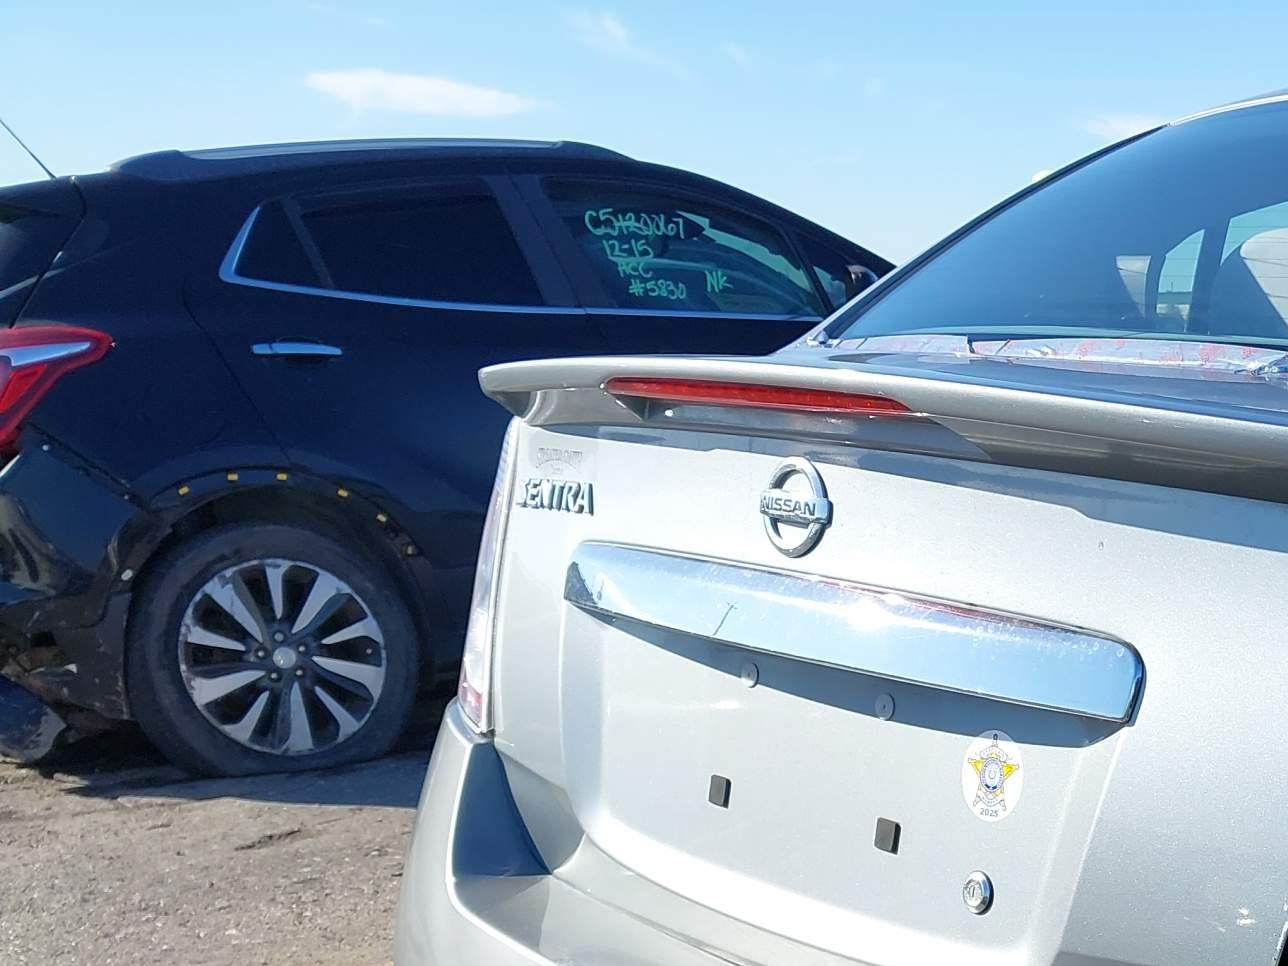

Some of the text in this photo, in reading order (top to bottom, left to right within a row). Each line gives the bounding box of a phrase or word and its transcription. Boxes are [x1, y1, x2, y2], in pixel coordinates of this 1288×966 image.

[602, 239, 654, 259] 12-15
[617, 261, 653, 278] ACC
[628, 278, 687, 300] #5830
[517, 478, 594, 516] SENTRA
[760, 495, 817, 518] NISSAN
[980, 807, 999, 818] 2025
